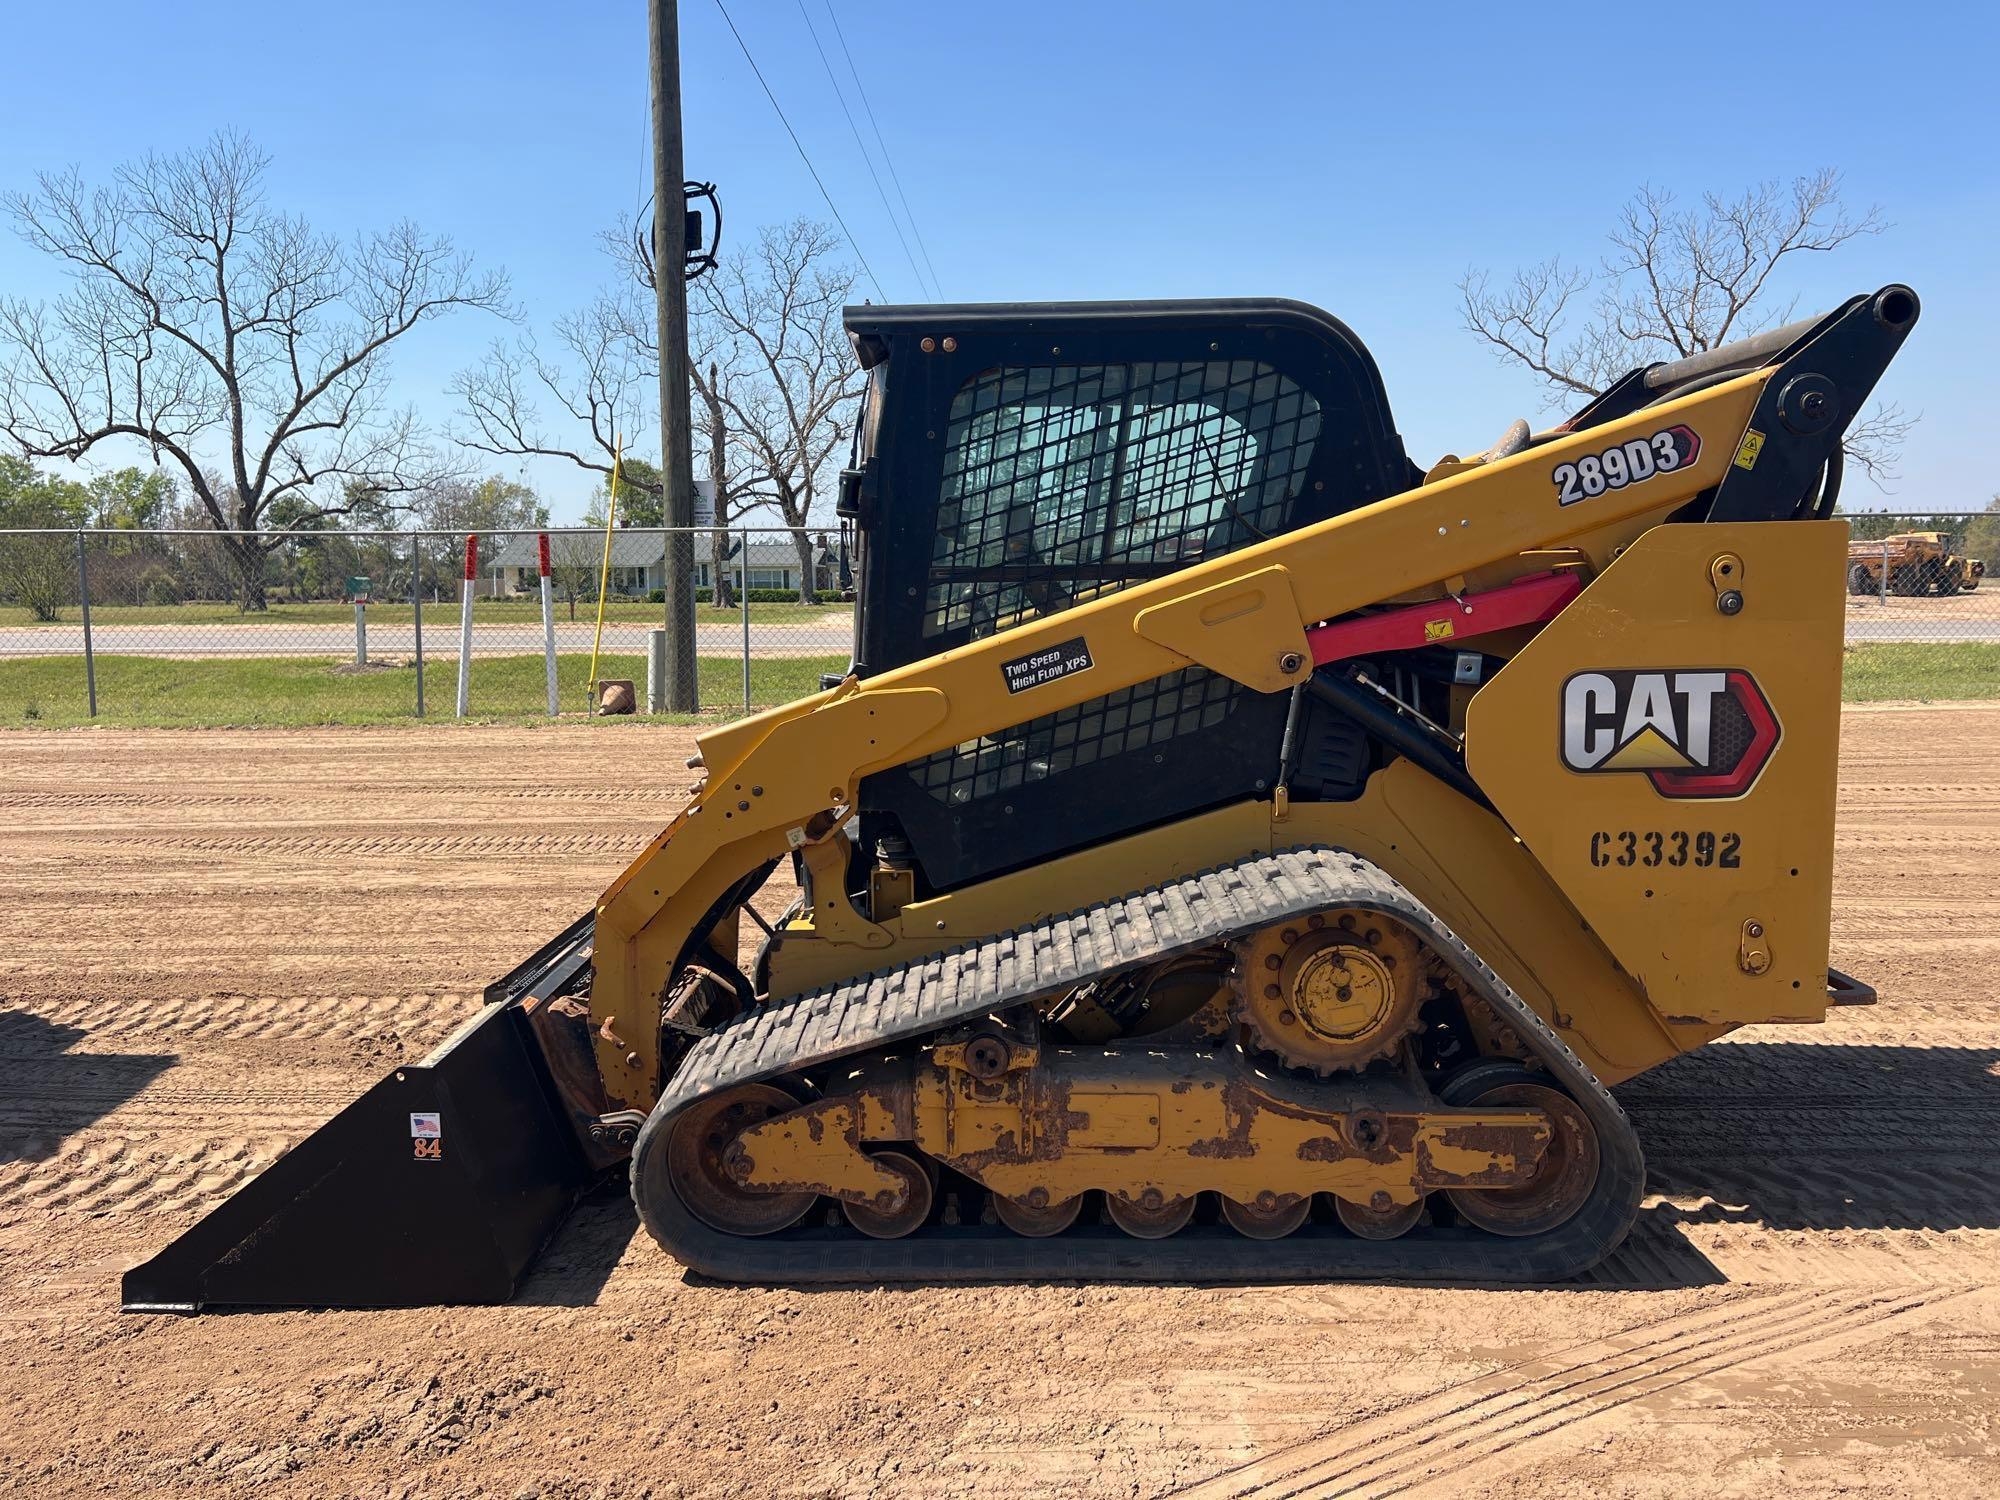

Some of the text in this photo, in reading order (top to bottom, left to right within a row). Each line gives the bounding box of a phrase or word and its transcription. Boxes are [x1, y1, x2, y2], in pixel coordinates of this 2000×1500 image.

[1554, 431, 1680, 504] 289D3
[1065, 655, 1087, 671] XPS
[1564, 673, 1727, 769] CAT
[1591, 831, 1741, 868] C33392
[414, 1138, 441, 1158] 84
